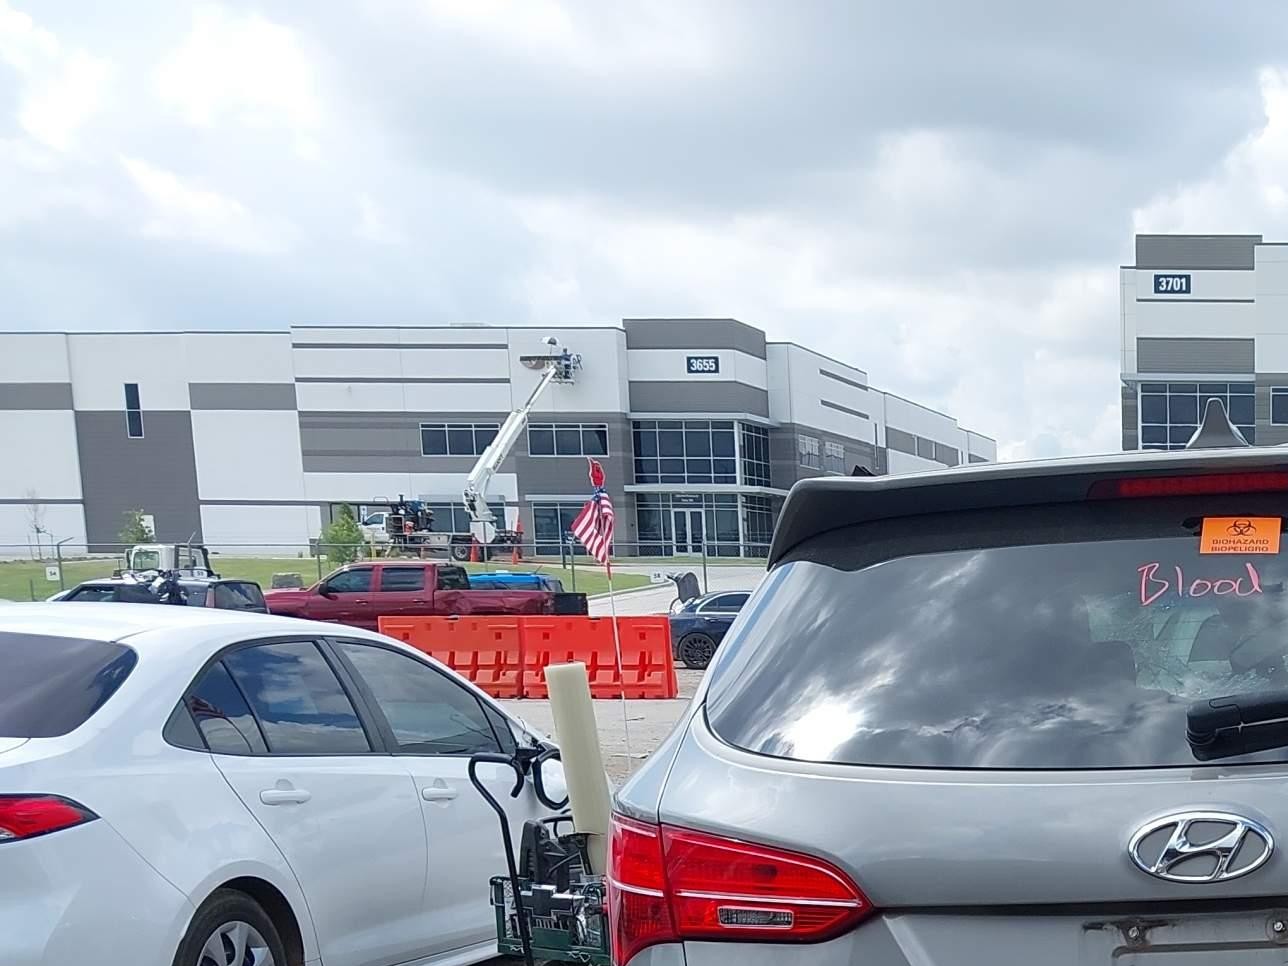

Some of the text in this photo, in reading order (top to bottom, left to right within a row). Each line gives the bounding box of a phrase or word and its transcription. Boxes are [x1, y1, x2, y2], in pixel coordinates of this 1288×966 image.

[1159, 277, 1186, 291] 3701
[690, 359, 716, 371] 3655
[1138, 562, 1262, 605] Blood
